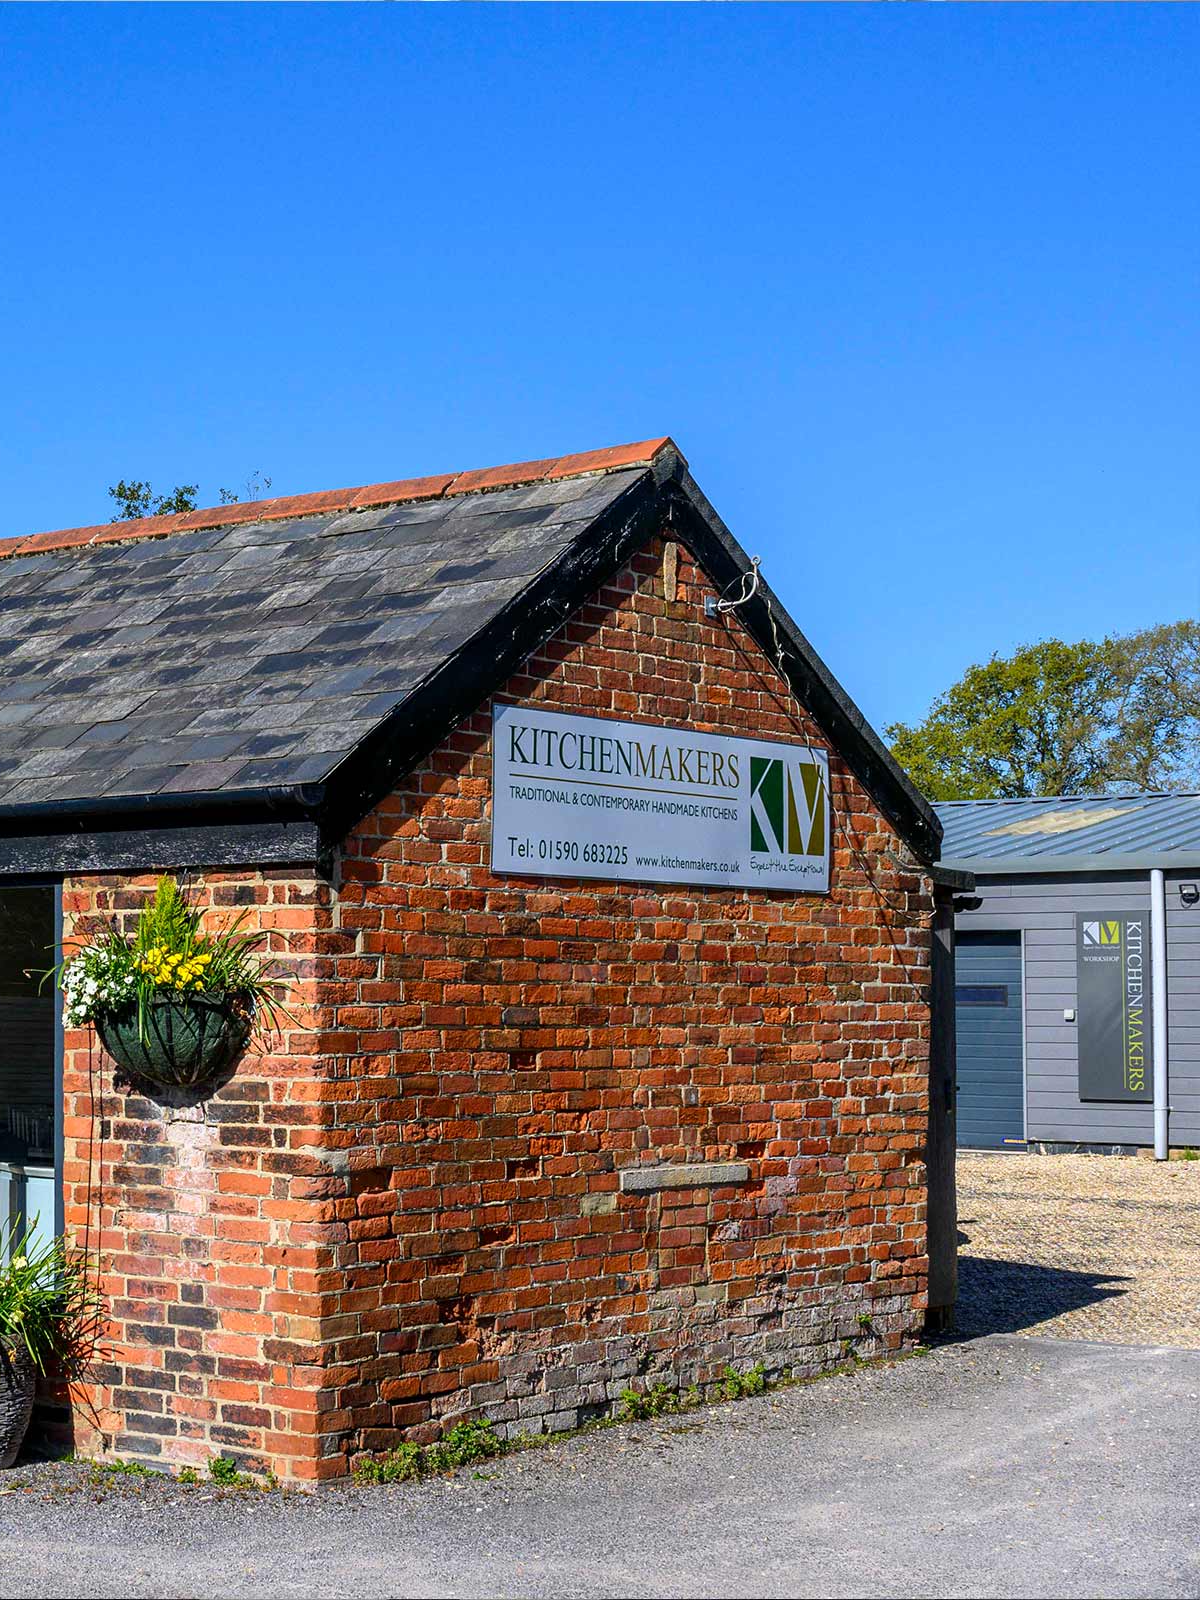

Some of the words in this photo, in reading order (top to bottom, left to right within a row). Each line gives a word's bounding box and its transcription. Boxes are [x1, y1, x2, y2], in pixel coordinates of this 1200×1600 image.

[508, 725, 740, 788] KITCHENMAKERS
[509, 785, 571, 804] TRADITIONAL
[572, 792, 579, 805] &
[580, 793, 650, 813] CONTEMPORARY
[651, 802, 699, 817] HANDMADE
[700, 806, 738, 821] KITCHENS
[508, 836, 534, 858] Tel:
[538, 839, 579, 861] 01590
[582, 843, 628, 865] 683225
[635, 854, 740, 873] www.kitchenmakers.co.uk
[1126, 920, 1144, 1092] KITCHENMAKERS
